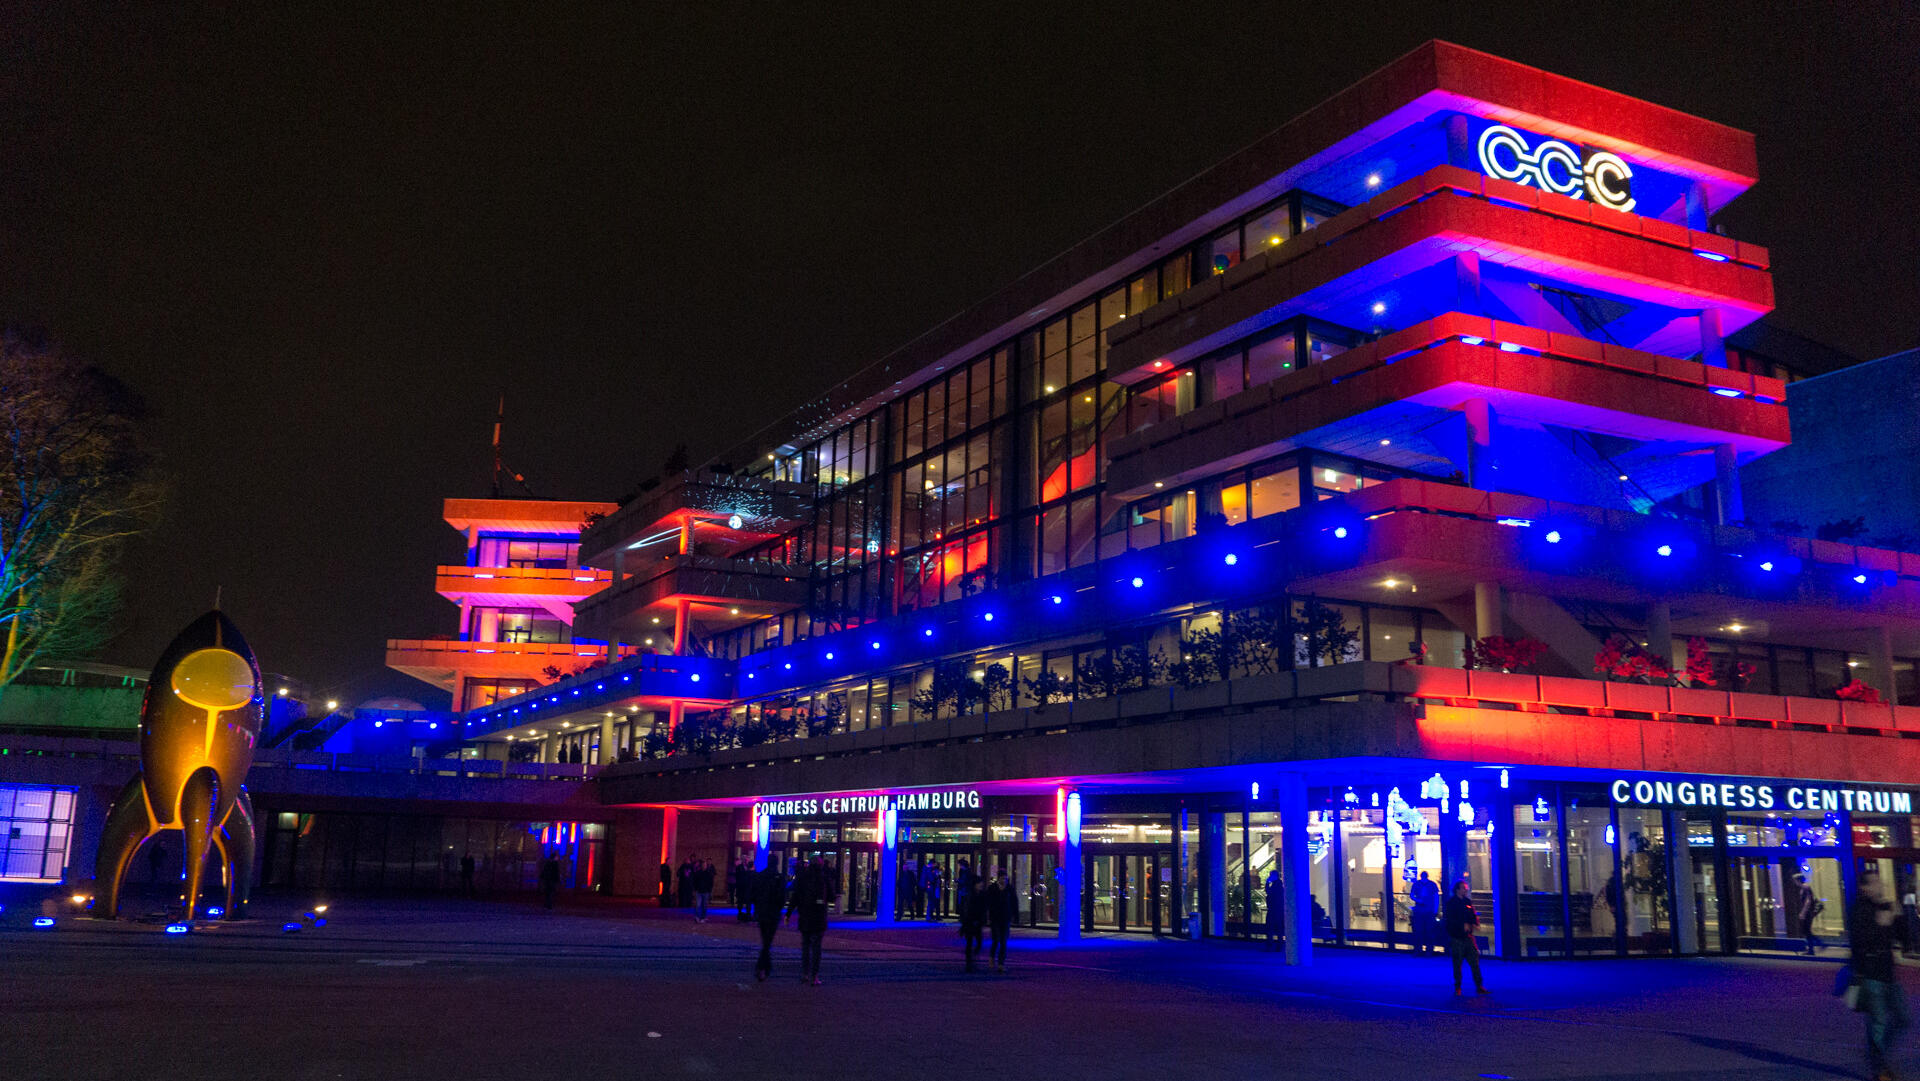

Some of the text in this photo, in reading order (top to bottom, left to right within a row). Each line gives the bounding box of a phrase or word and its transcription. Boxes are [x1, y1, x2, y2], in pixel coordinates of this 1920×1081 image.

[754, 790, 980, 817] CONGRESS CENTRUM HAMBURG
[1611, 779, 1912, 814] CONGRESS CENTRUM
